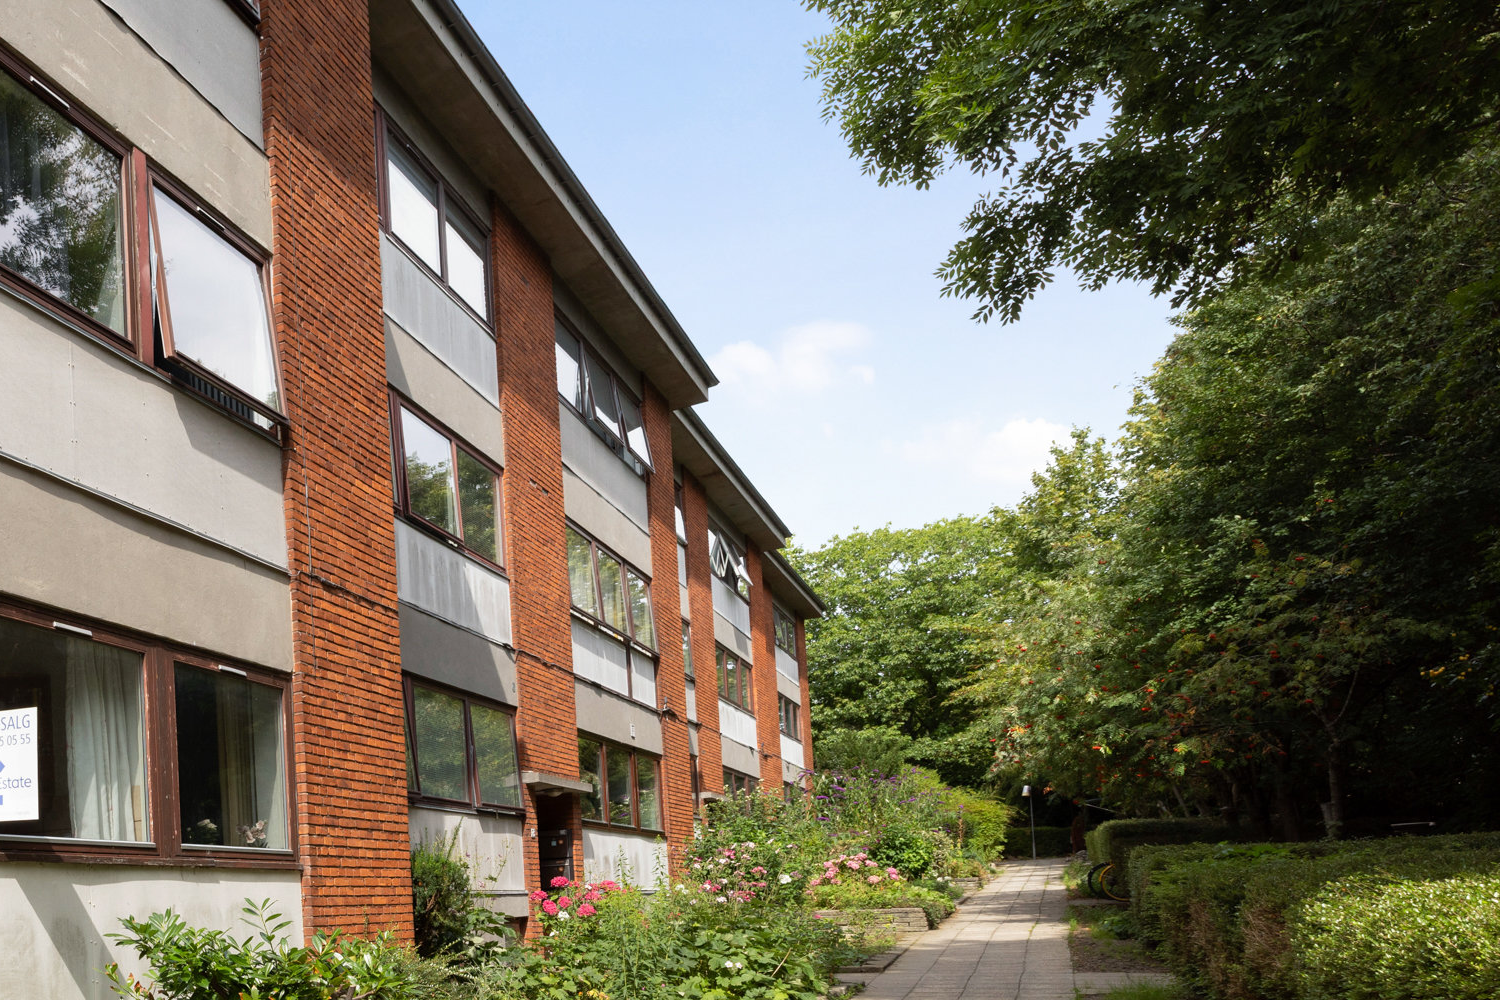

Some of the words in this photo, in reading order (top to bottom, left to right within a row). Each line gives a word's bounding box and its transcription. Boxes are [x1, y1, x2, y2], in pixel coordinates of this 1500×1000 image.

[0, 714, 31, 731] SALG
[6, 734, 18, 746] 05
[20, 733, 31, 745] 55
